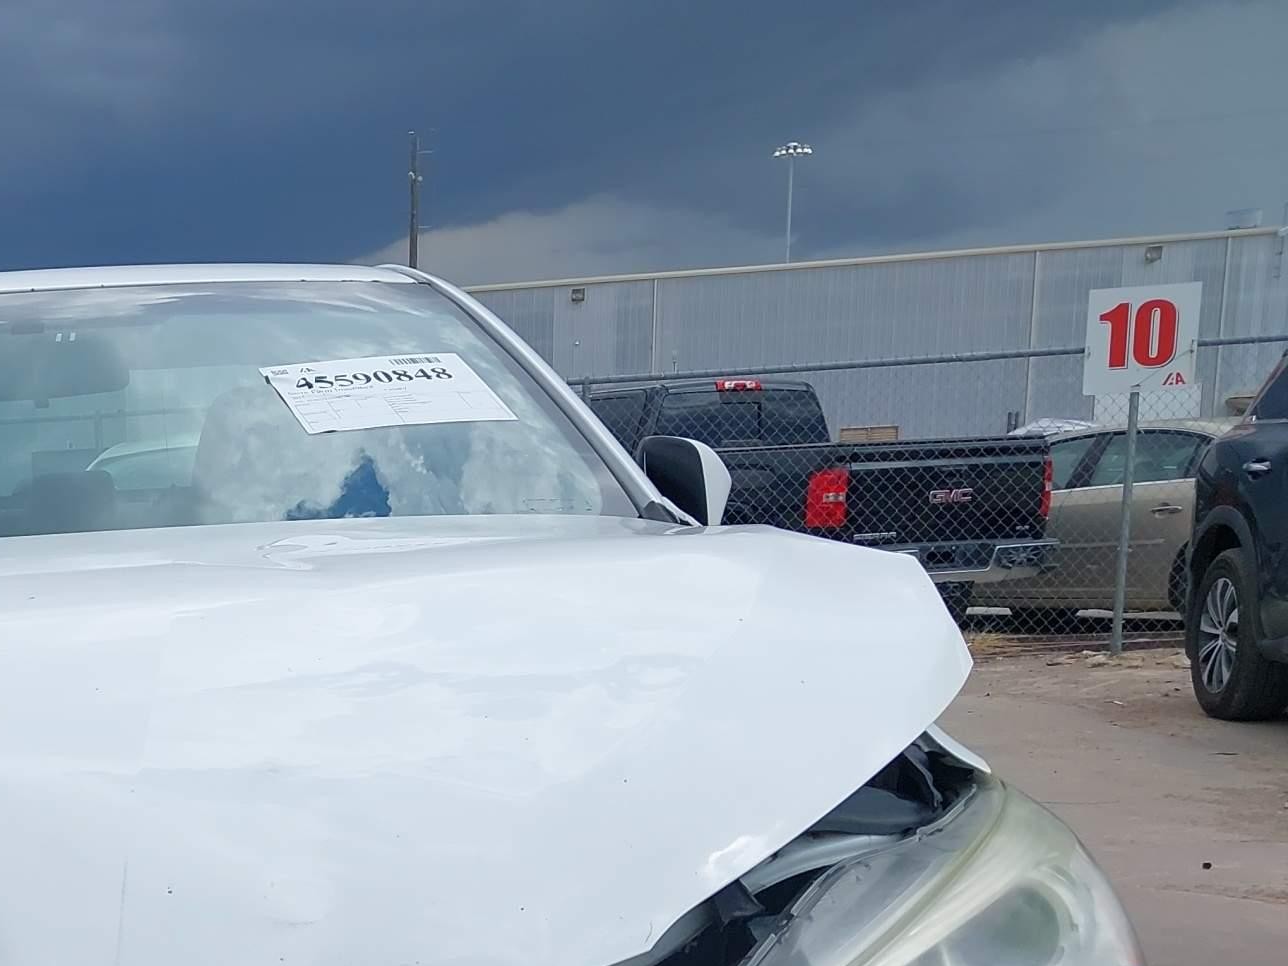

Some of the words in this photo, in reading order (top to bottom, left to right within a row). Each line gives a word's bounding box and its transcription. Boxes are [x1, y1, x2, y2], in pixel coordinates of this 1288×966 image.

[1098, 299, 1180, 370] 10
[295, 366, 454, 390] 45590848
[929, 487, 974, 504] GMC
